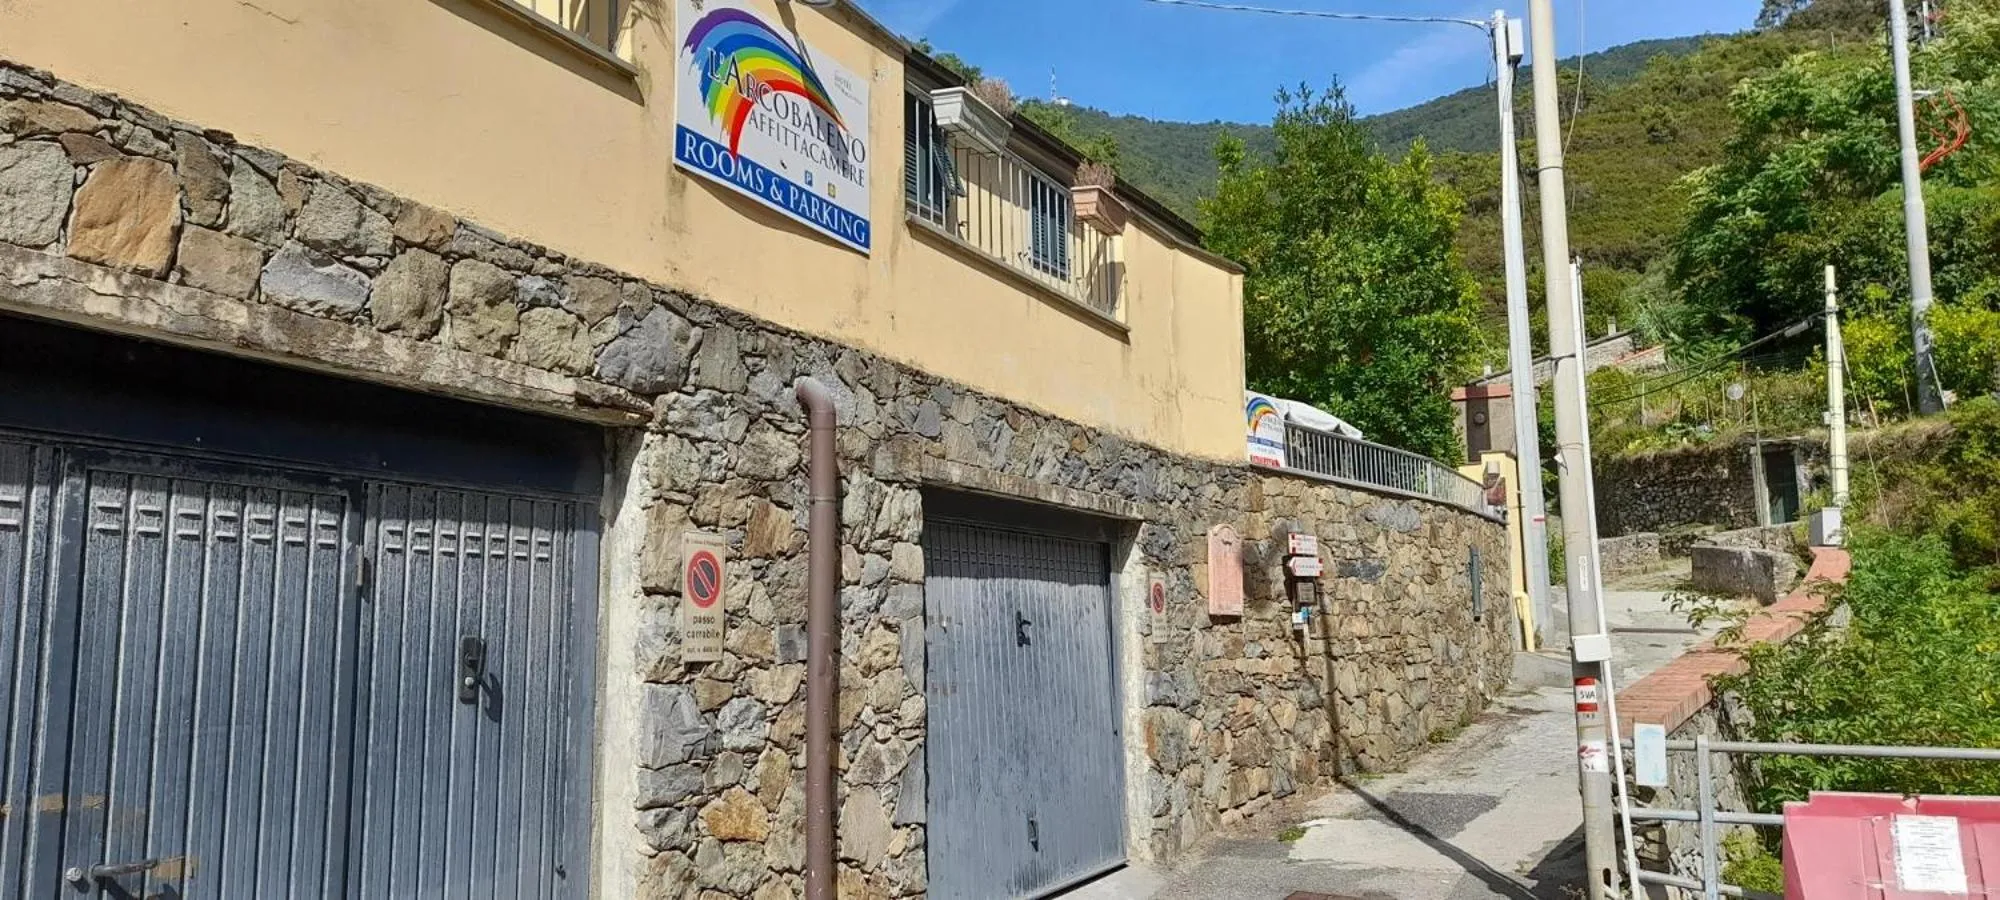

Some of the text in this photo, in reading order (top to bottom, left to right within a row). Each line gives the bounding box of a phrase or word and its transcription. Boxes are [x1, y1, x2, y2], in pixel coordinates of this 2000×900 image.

[708, 47, 866, 164] L'ARCOBALENO
[748, 110, 865, 188] AFFITTACAMERE
[684, 132, 866, 243] ROOMS & PARKING
[692, 615, 716, 625] passo
